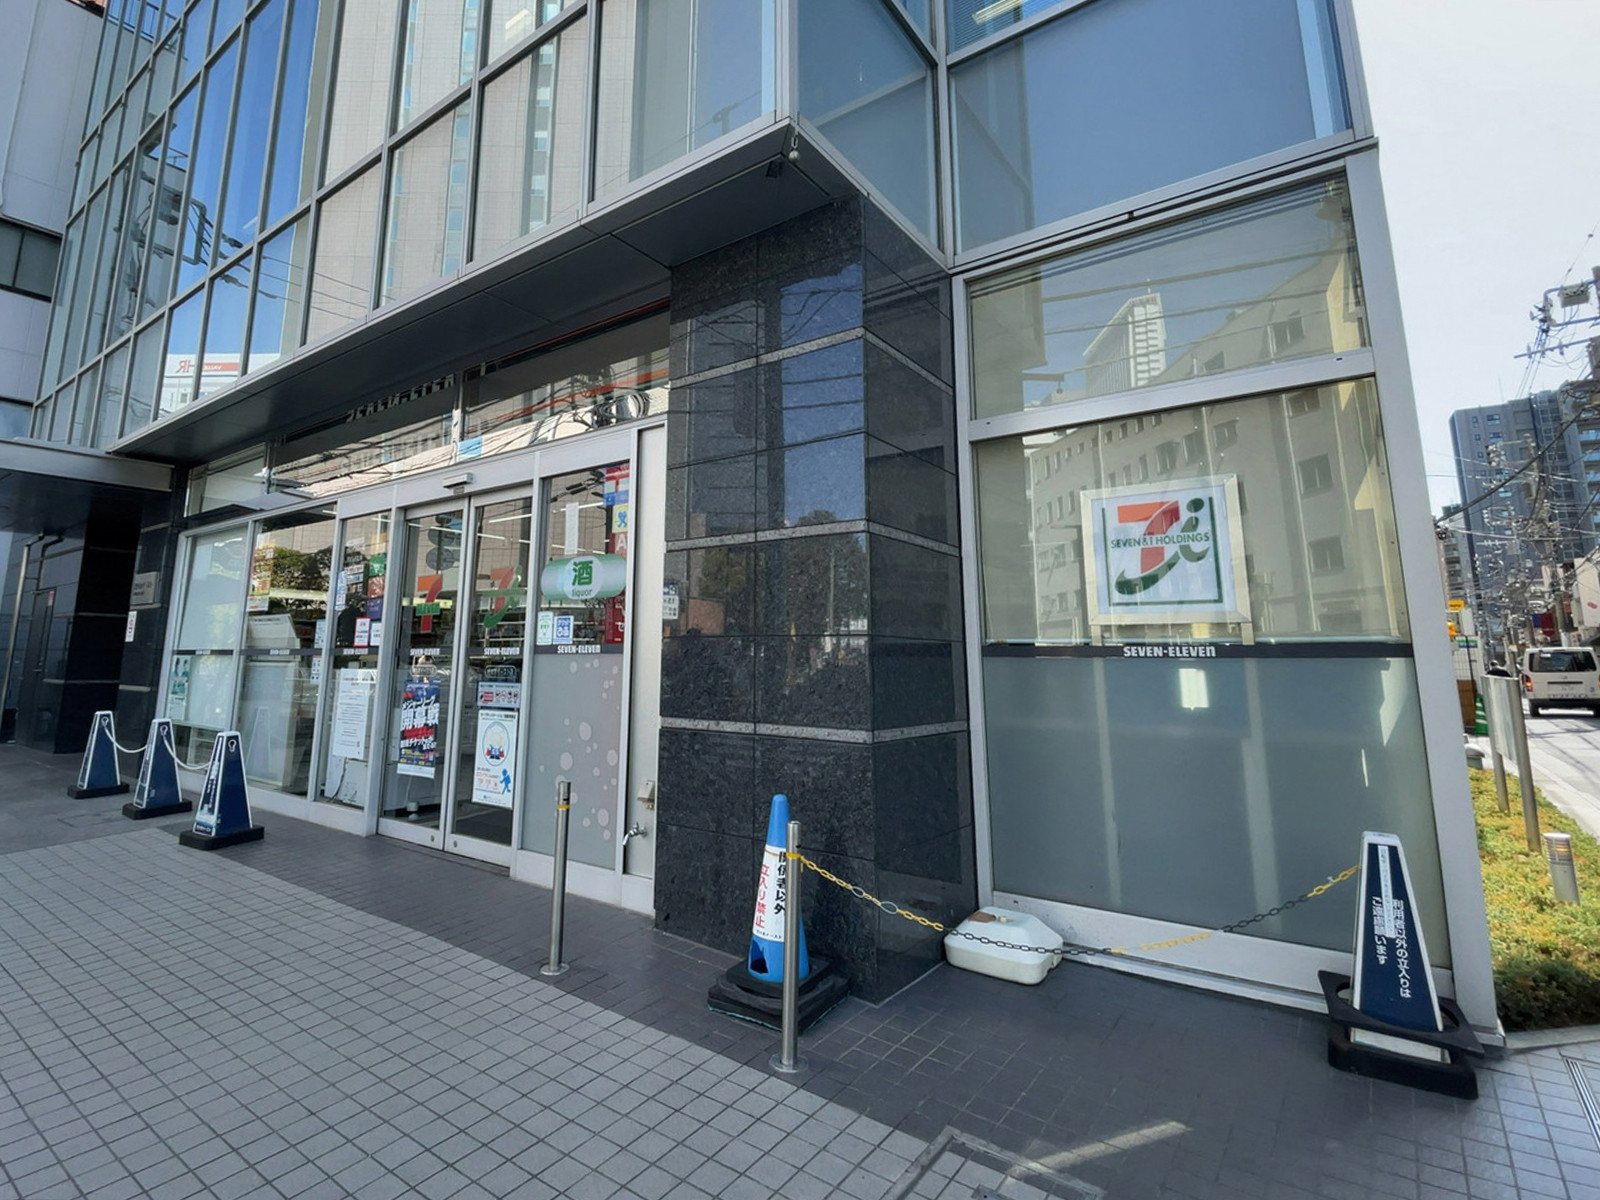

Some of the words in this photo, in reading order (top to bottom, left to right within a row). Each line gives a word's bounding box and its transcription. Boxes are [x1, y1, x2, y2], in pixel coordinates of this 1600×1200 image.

[1155, 532, 1210, 546] HOLDINGS
[572, 560, 594, 587] 酒
[571, 587, 593, 599] liquor
[755, 865, 771, 928] 立入り禁止
